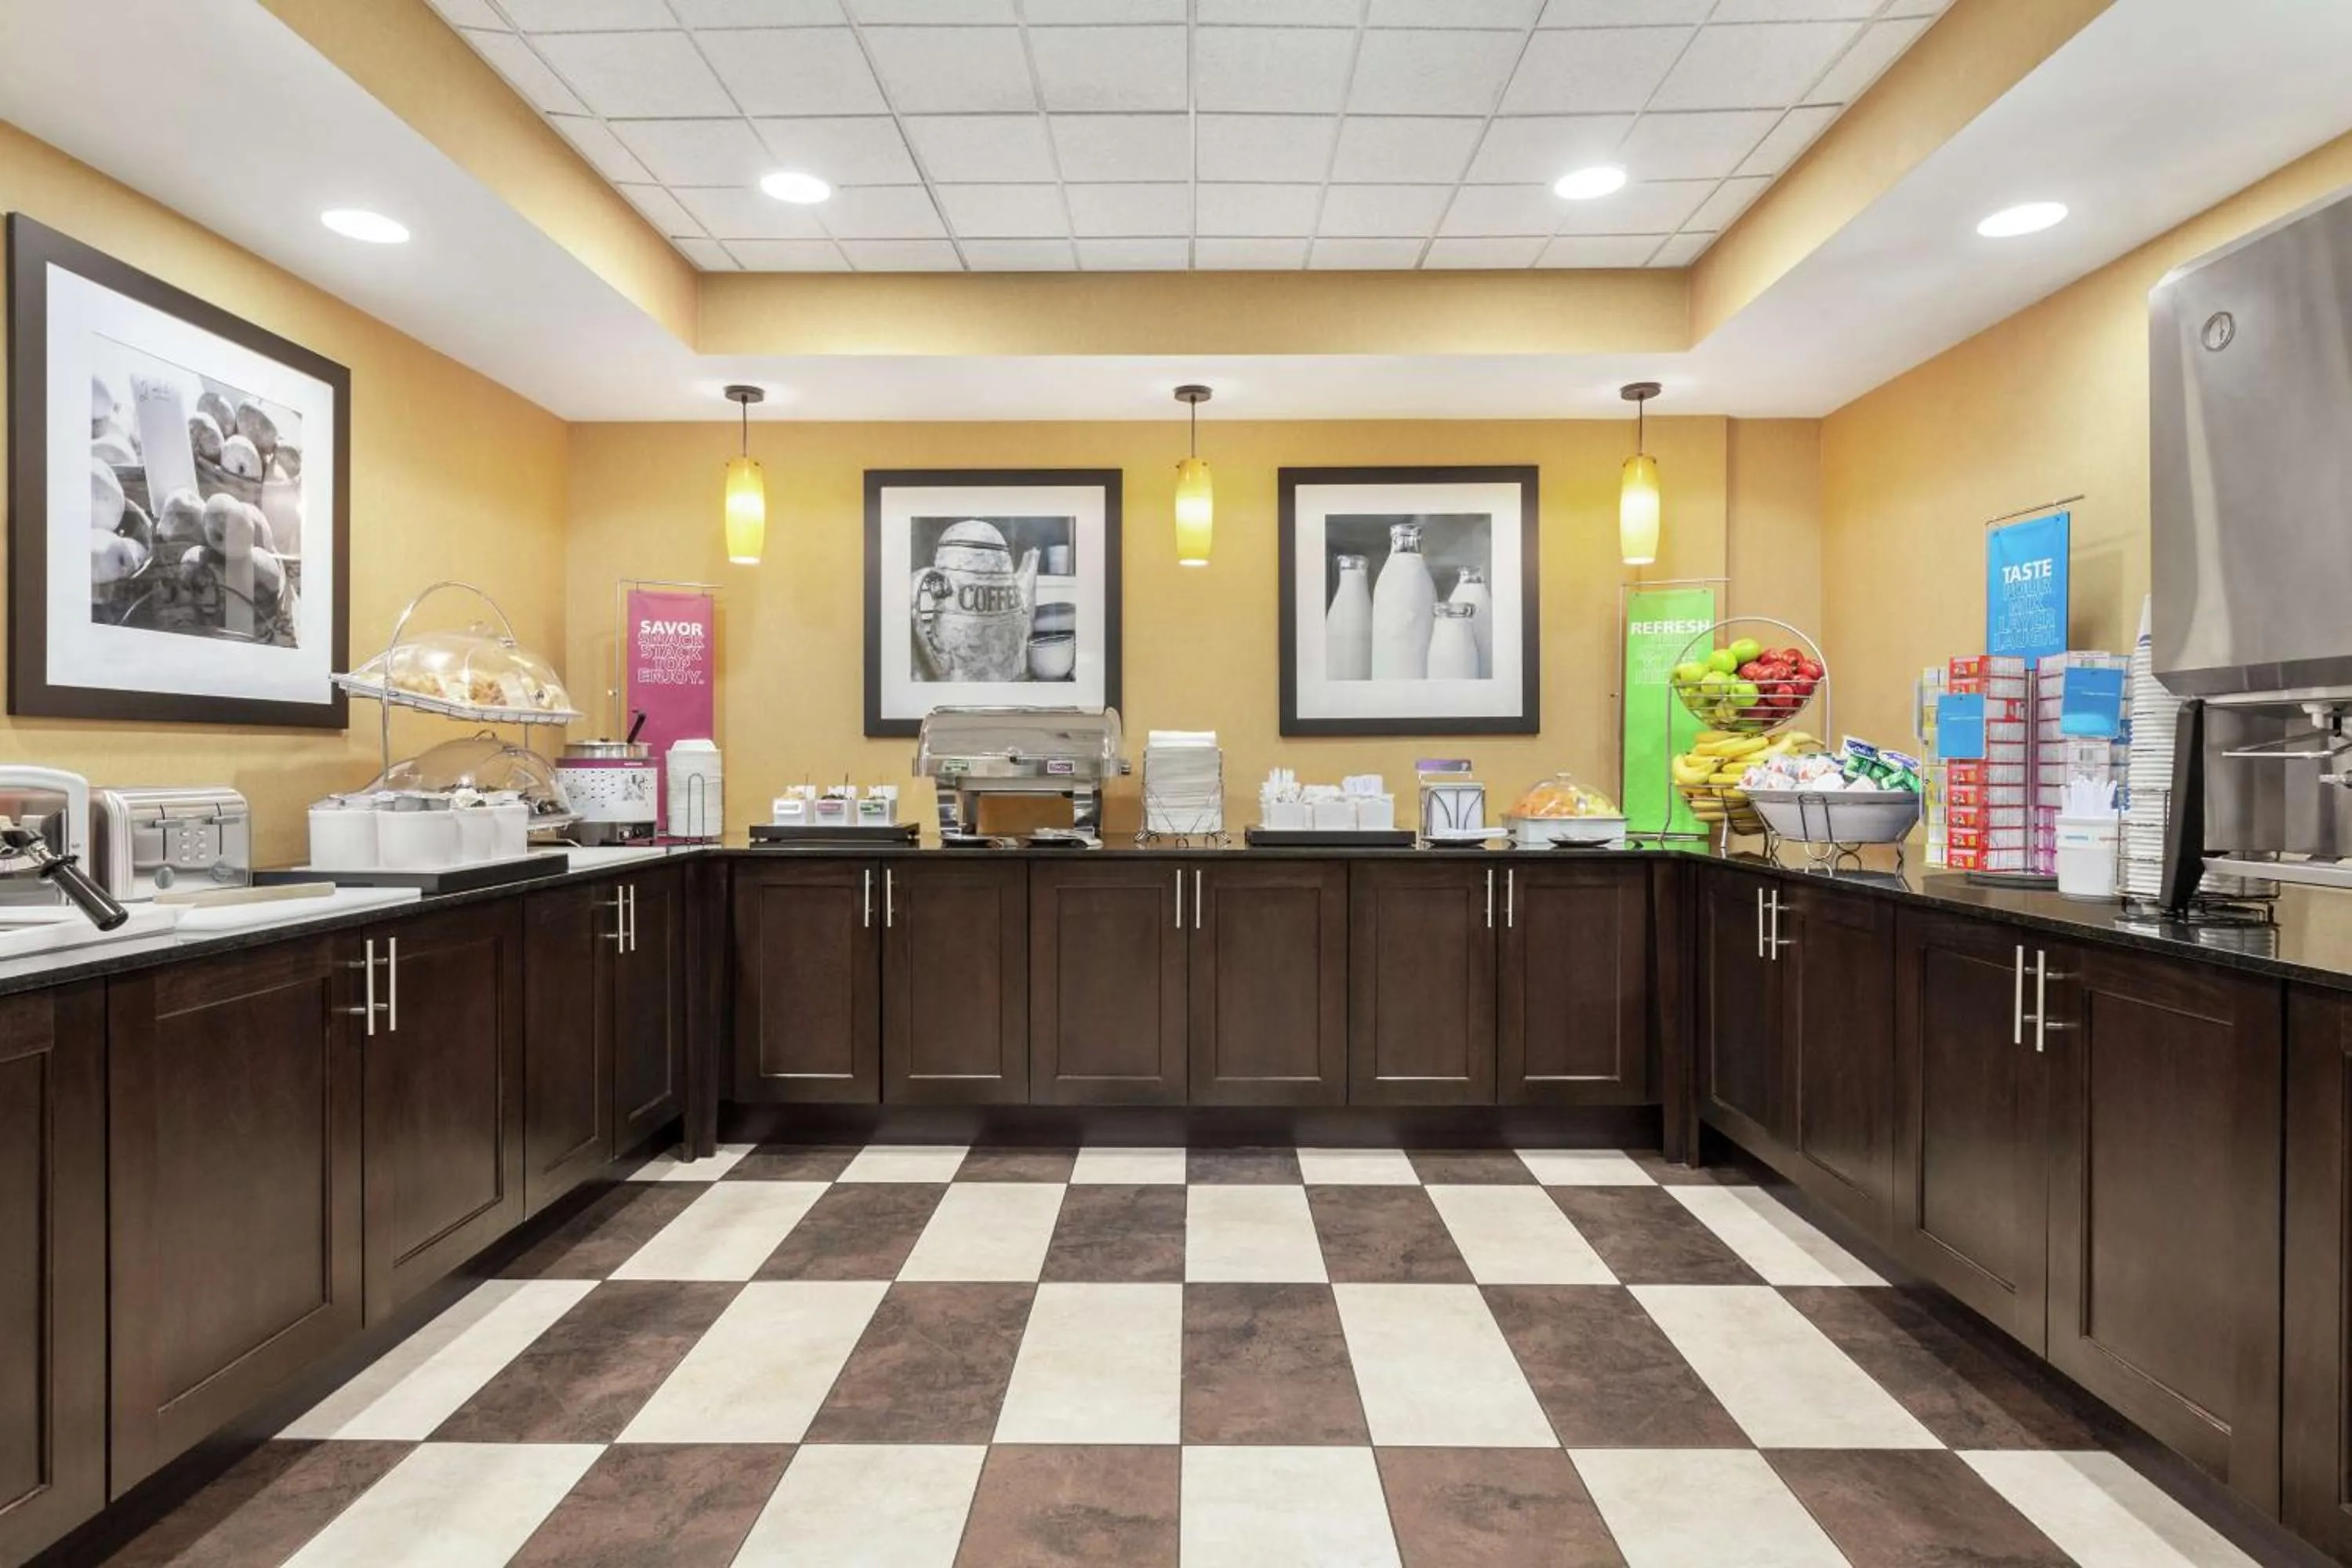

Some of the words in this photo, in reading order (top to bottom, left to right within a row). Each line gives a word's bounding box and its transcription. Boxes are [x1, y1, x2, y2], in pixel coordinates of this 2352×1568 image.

[2002, 557, 2053, 583] TASTE
[640, 620, 703, 635] SAVOR
[1630, 619, 1710, 635] REFRESH
